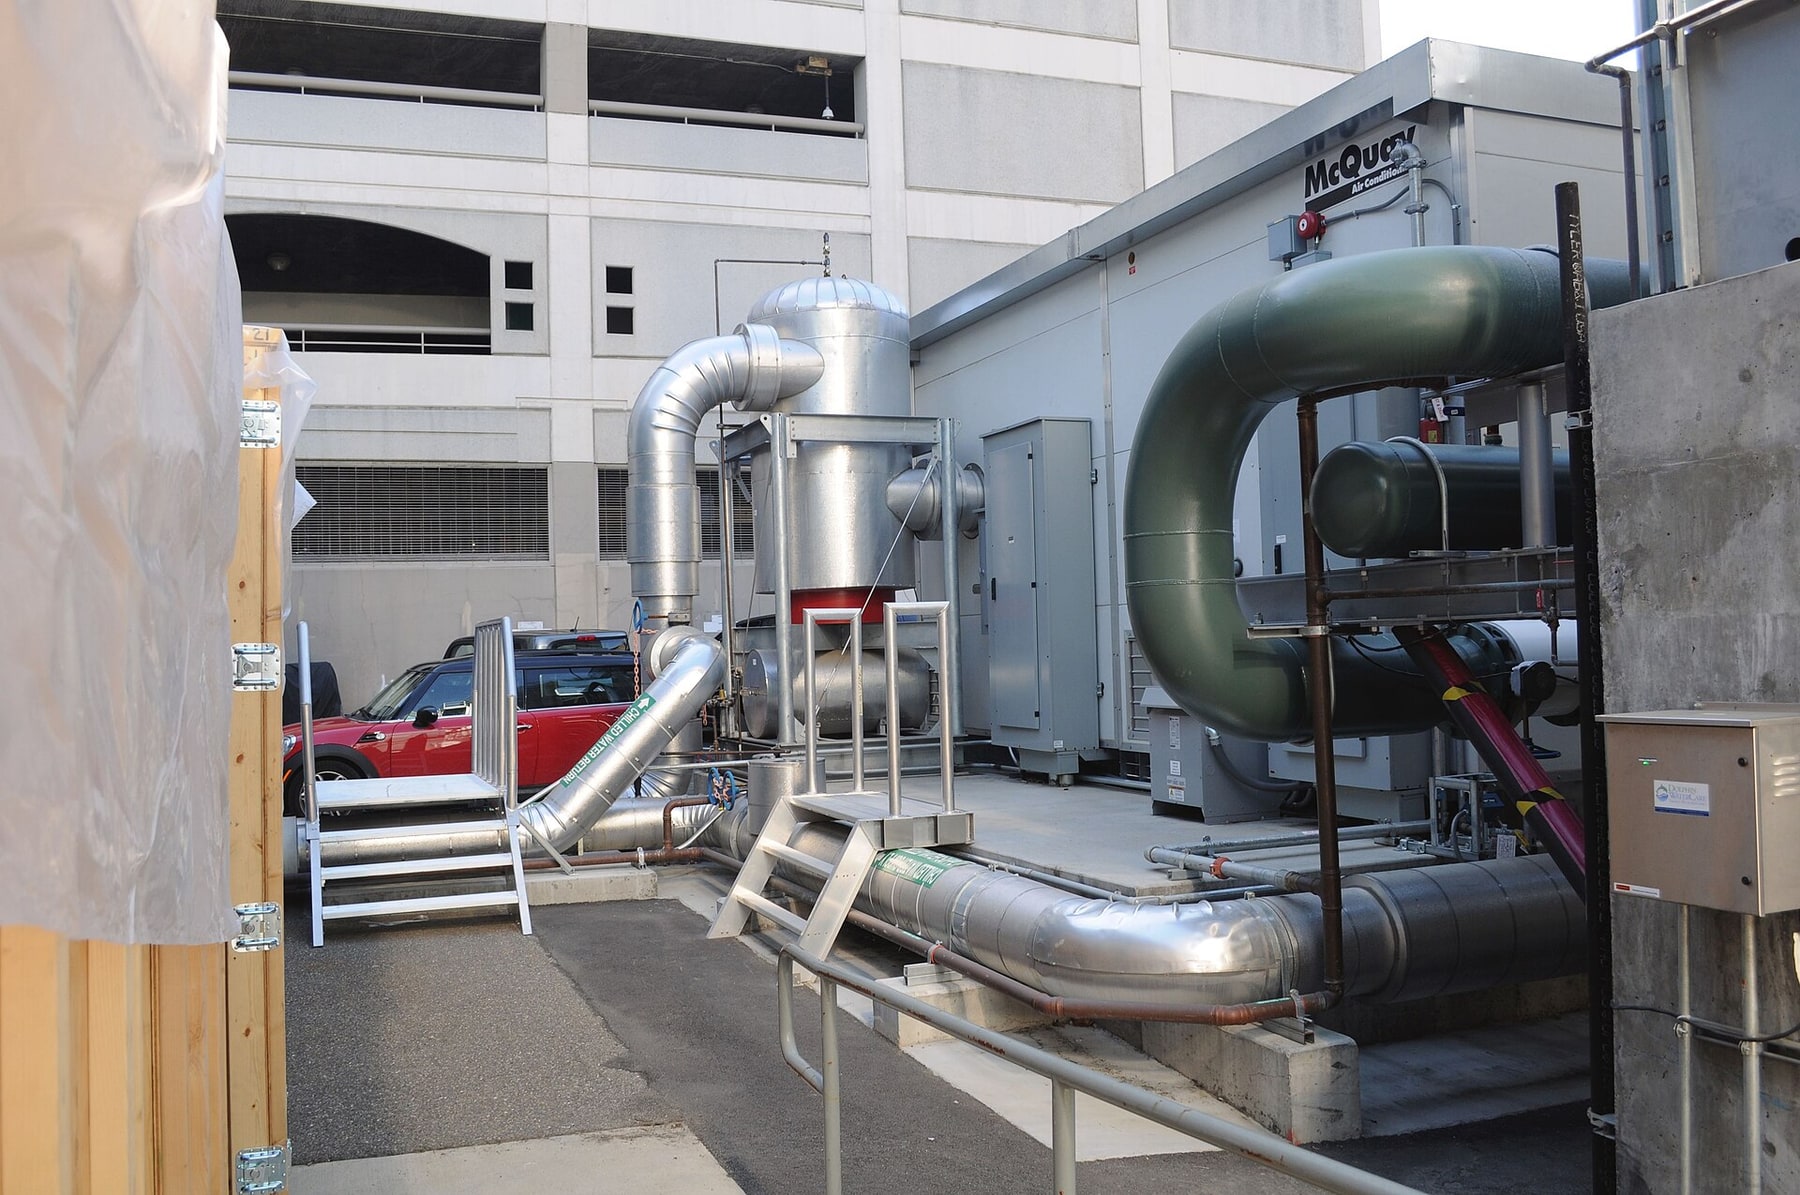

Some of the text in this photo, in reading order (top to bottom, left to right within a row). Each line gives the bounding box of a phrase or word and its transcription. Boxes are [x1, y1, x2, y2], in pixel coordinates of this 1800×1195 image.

[1305, 125, 1416, 198] McQuay
[1352, 181, 1363, 194] Air
[564, 707, 640, 784] CHILLED WATER RETURN
